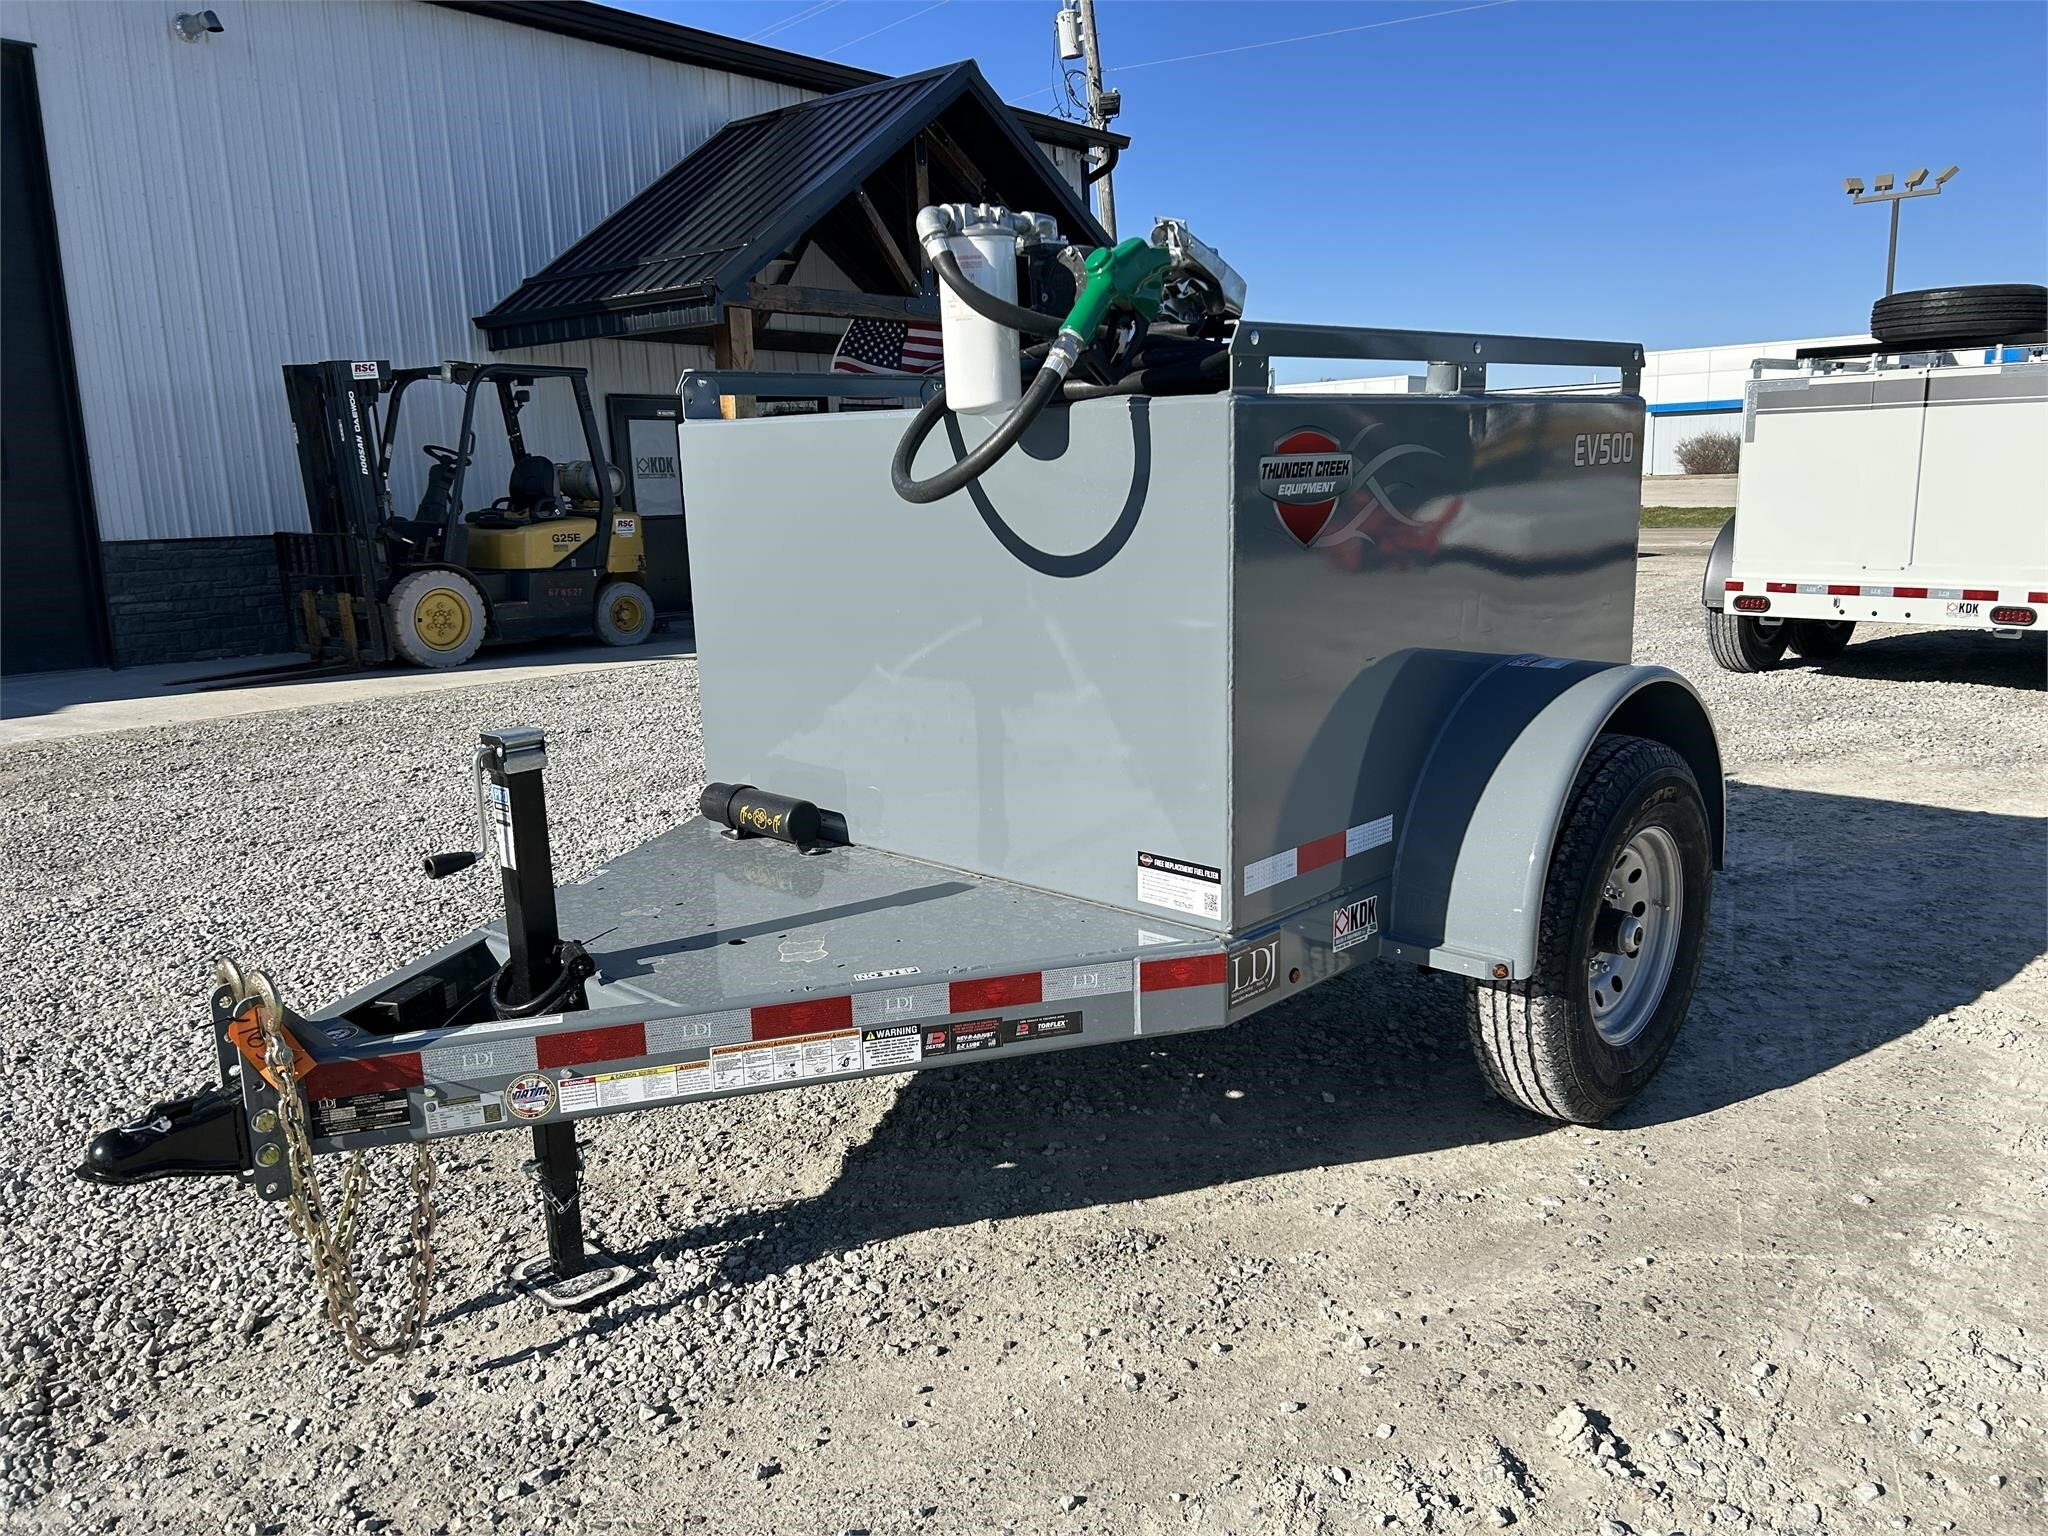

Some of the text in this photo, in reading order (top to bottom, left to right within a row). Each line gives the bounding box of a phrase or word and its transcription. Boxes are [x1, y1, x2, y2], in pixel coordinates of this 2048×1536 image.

[354, 364, 375, 373] RSC
[348, 390, 369, 475] DOOSAN DAEWOO
[1574, 431, 1634, 467] EV500
[650, 456, 675, 473] KDK
[1262, 460, 1351, 479] THUNDER CREEK
[1278, 482, 1337, 496] EQUIPMENT
[617, 520, 634, 528] RSC
[552, 533, 581, 543] G25E
[1958, 602, 1980, 614] KDK
[1153, 858, 1219, 880] FREE REPLACEMENT FUEL FILTER
[1350, 897, 1377, 932] KDK
[1232, 940, 1279, 993] LDJ
[885, 996, 913, 1011] LDJ
[875, 1025, 918, 1039] WARNING
[1037, 1020, 1066, 1029] TORFLEX
[462, 1050, 494, 1068] LDJ
